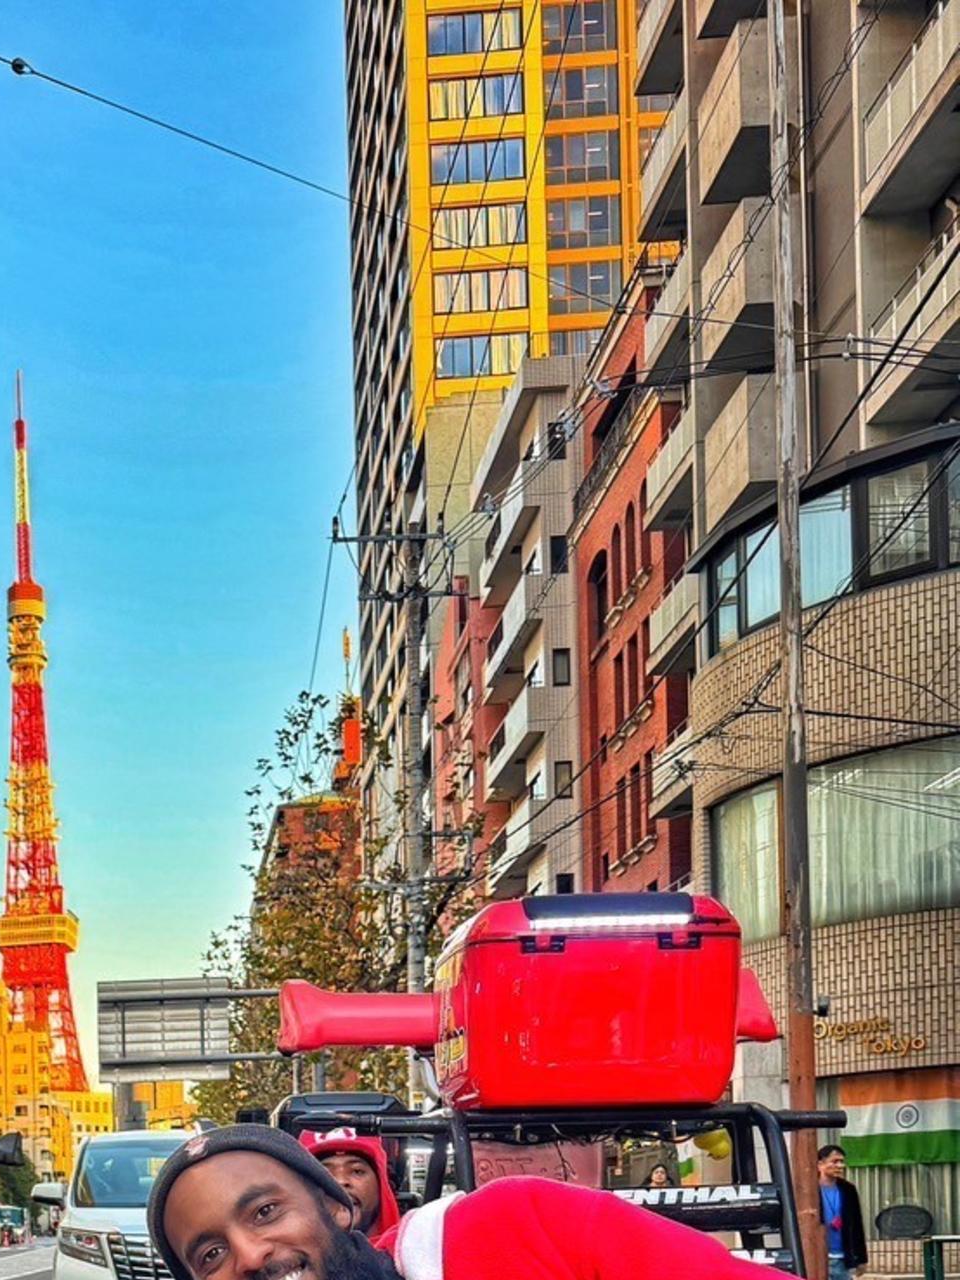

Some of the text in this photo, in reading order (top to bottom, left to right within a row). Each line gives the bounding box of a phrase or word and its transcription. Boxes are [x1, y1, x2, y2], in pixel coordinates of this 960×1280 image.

[814, 1016, 889, 1041] Organic
[863, 1034, 925, 1057] Tokyo
[611, 1184, 762, 1205] ENTHAL
